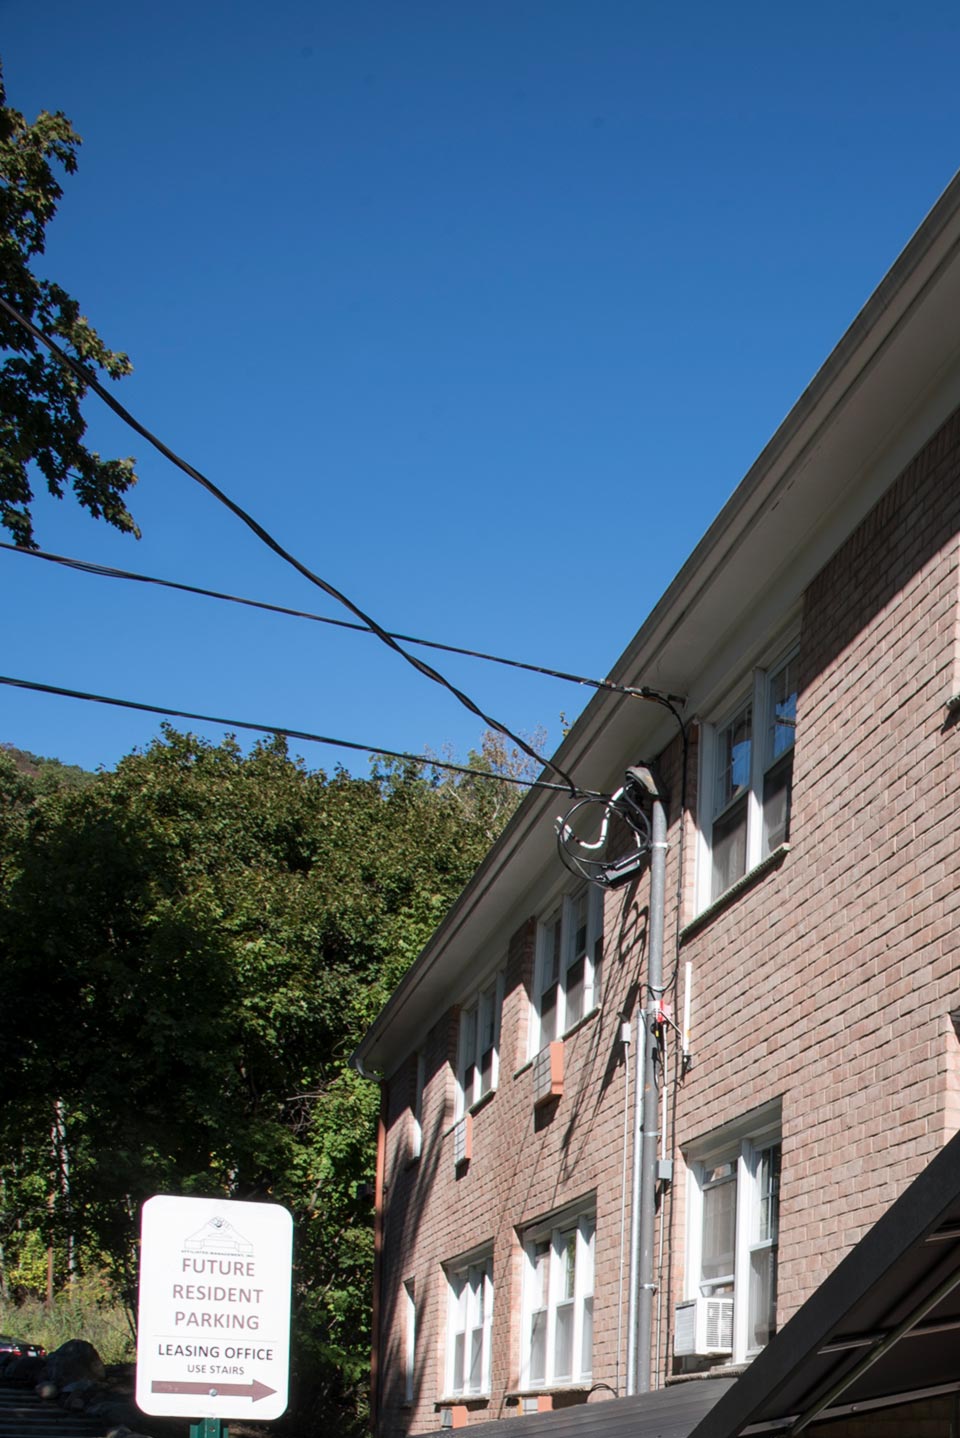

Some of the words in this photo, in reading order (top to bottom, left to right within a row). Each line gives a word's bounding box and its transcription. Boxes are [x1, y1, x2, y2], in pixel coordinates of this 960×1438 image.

[182, 1257, 255, 1277] FUTURE
[172, 1283, 264, 1304] RESIDENT
[174, 1311, 259, 1331] PARKING
[158, 1343, 220, 1359] LEASING
[224, 1346, 274, 1361] OFFICE
[187, 1364, 207, 1374] USE
[209, 1364, 245, 1376] STAIRS
